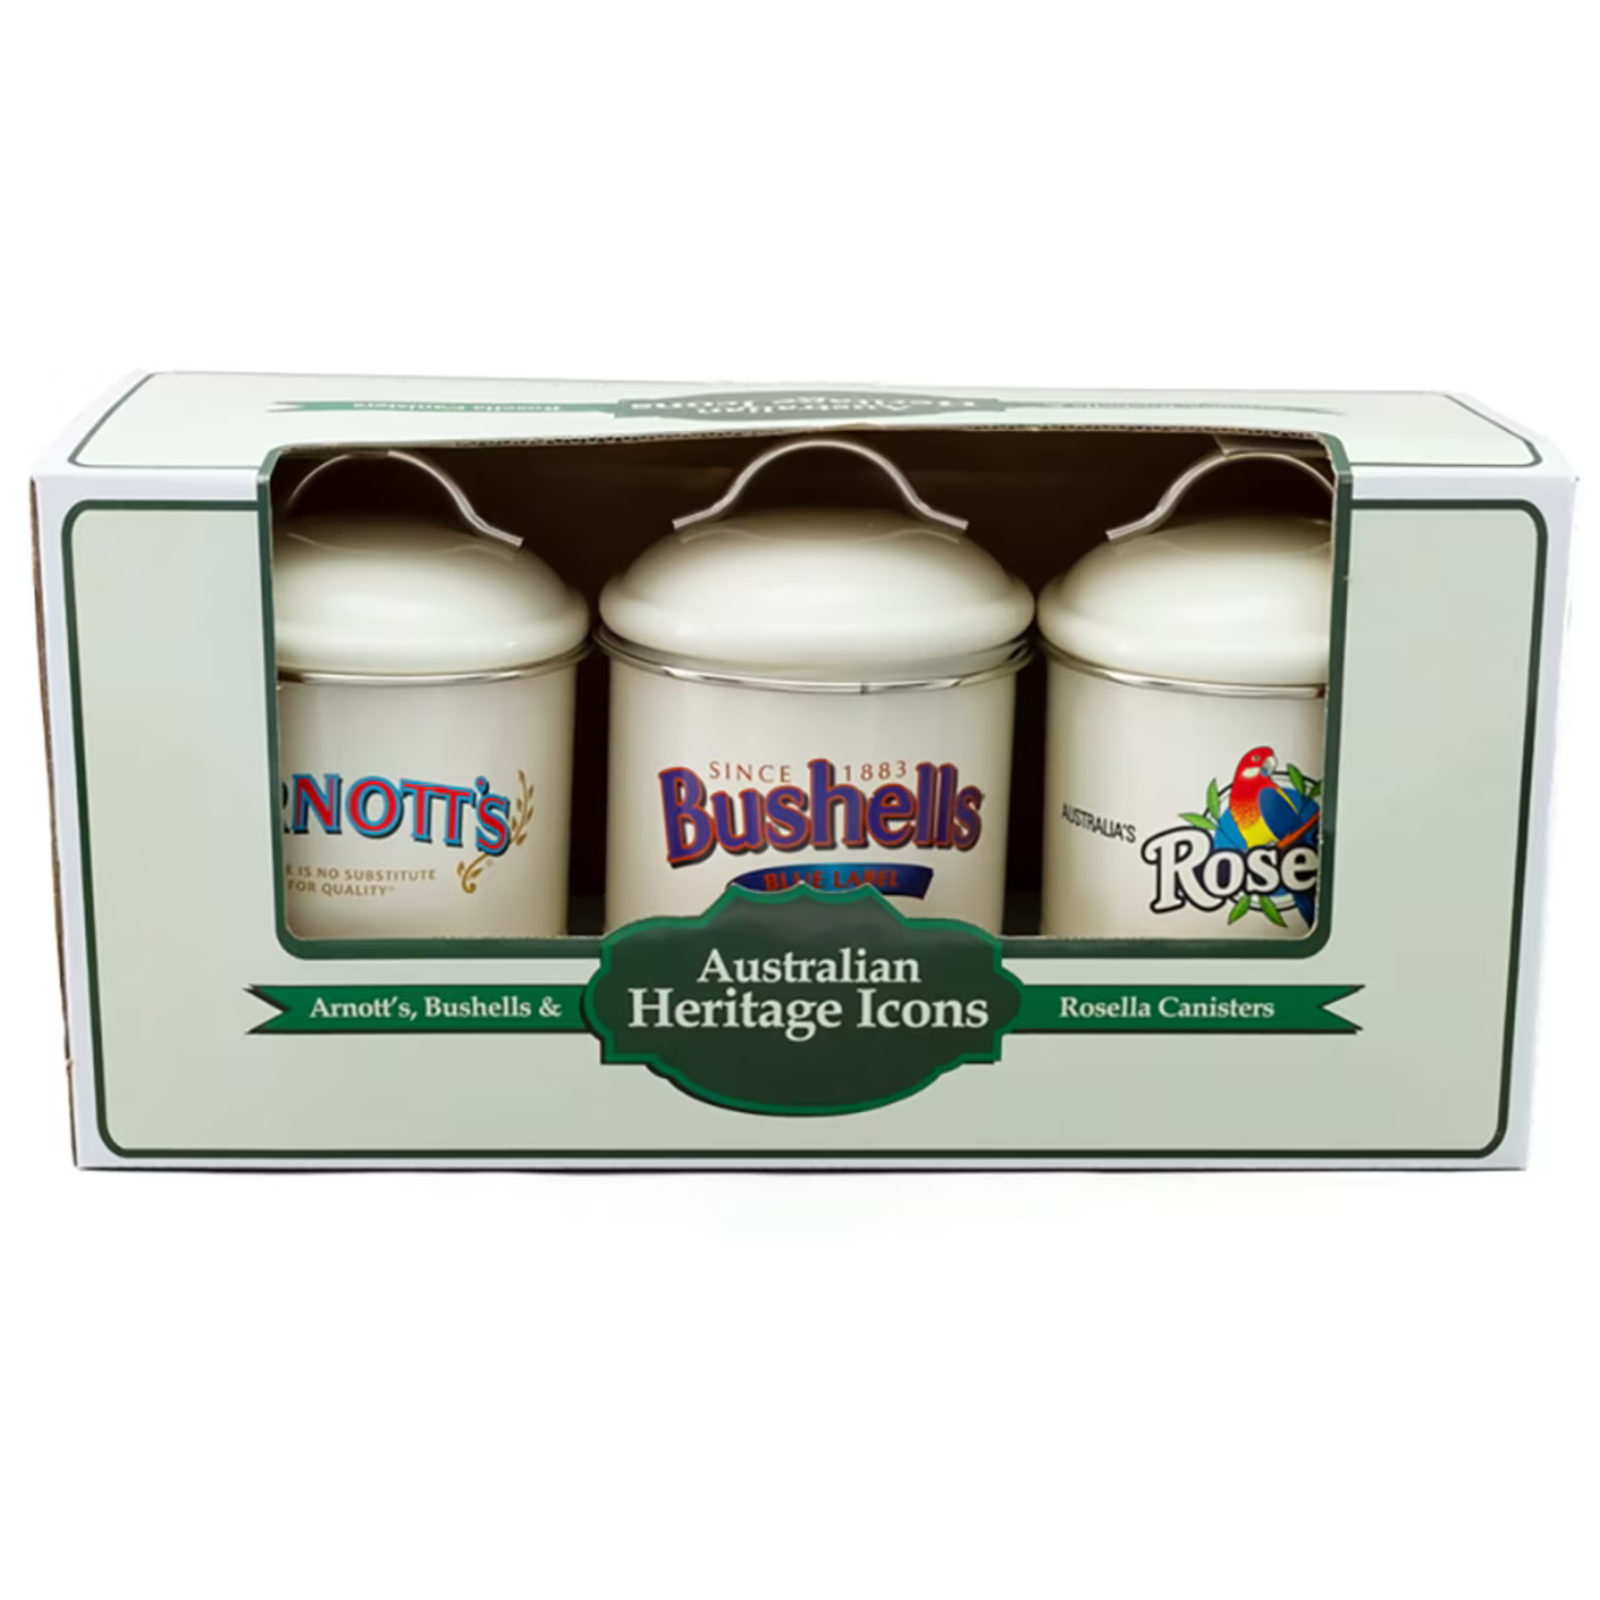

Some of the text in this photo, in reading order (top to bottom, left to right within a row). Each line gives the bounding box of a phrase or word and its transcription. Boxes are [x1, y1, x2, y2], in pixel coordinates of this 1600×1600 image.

[709, 760, 908, 784] SINCE 1883
[283, 773, 511, 857] NOTT'S
[658, 758, 985, 869] Bushells
[1061, 803, 1137, 843] AUSTRALIA'S
[298, 865, 312, 878] IS
[316, 867, 340, 880] NO
[344, 868, 436, 882] SUBSTITUTE
[832, 868, 899, 889] LABEL
[287, 880, 317, 893] FOR
[697, 947, 921, 983] Australian
[310, 996, 562, 1021] Arnott's, Bushells &
[628, 988, 989, 1042] Heritage Icons
[1060, 996, 1275, 1018] Rosella Canisters
